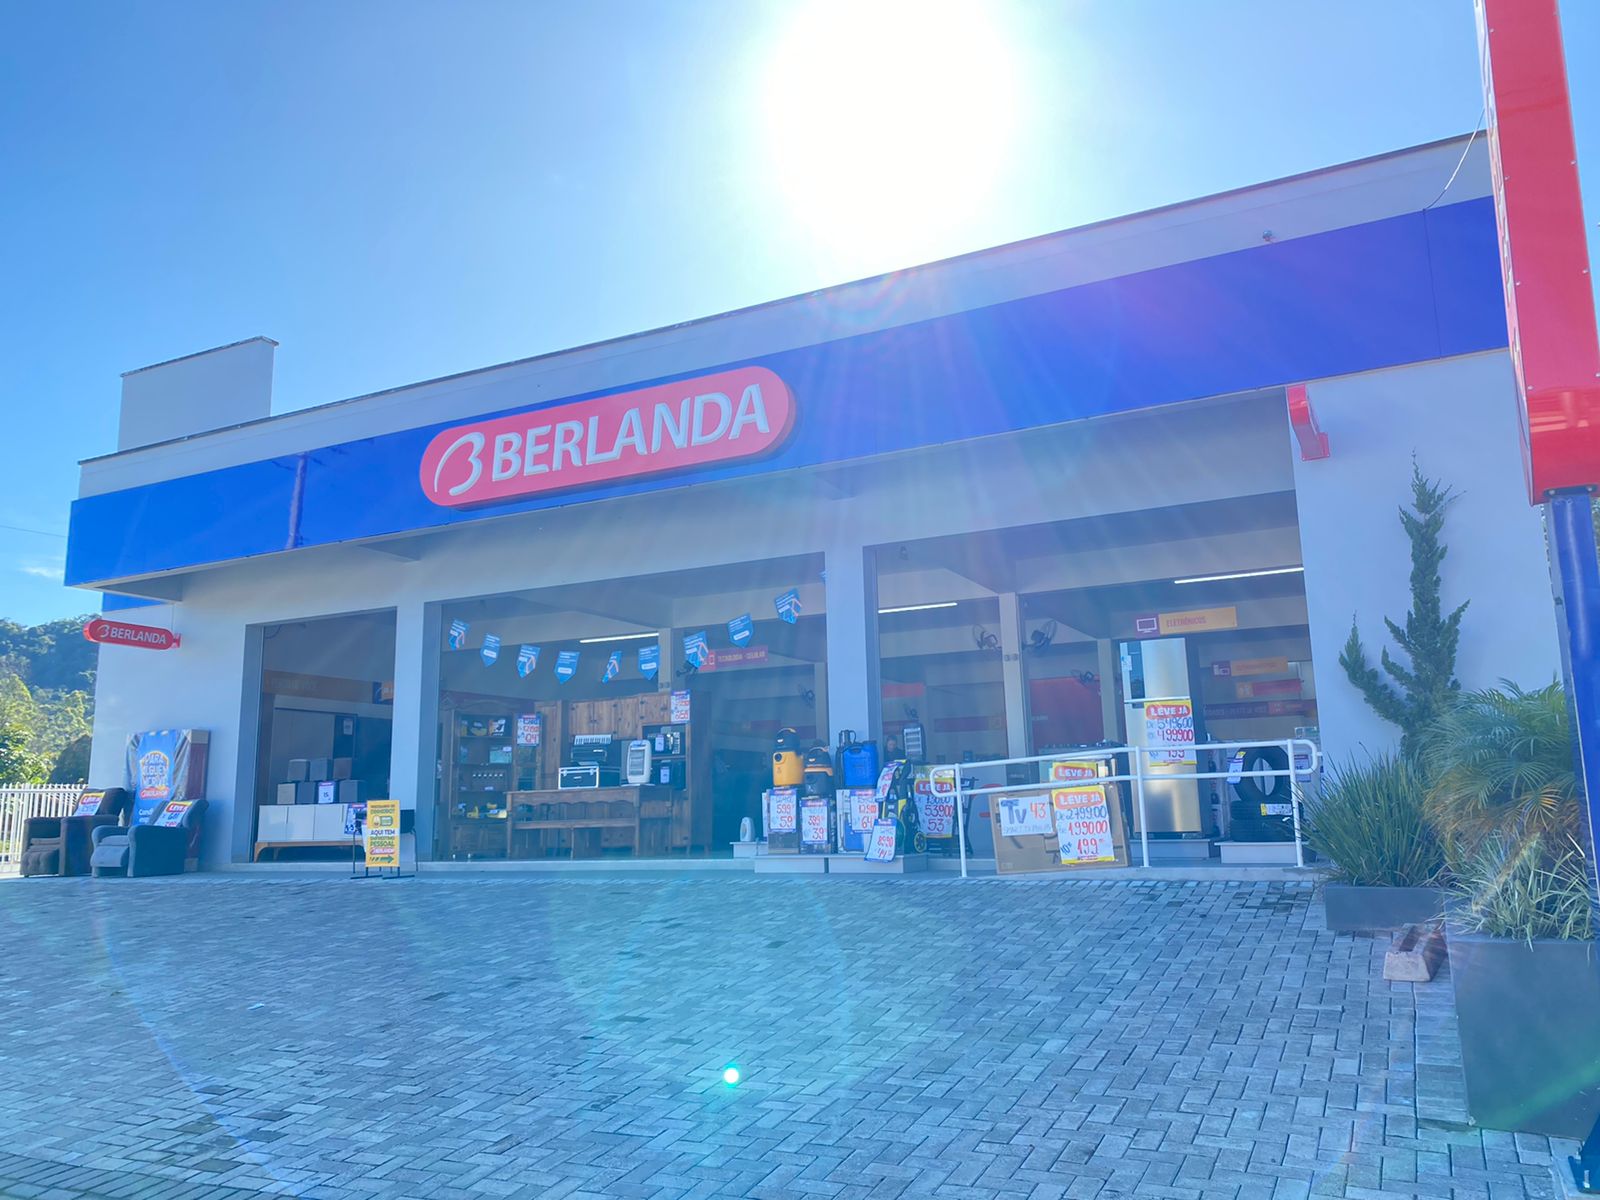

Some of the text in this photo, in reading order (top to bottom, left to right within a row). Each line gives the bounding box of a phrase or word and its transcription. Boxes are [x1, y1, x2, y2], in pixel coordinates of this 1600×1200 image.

[491, 383, 771, 483] BERLANDA
[110, 627, 167, 644] BERLANDA
[1150, 706, 1177, 716] LEVE
[1058, 768, 1082, 778] LEVE
[1059, 796, 1088, 806] LEVE
